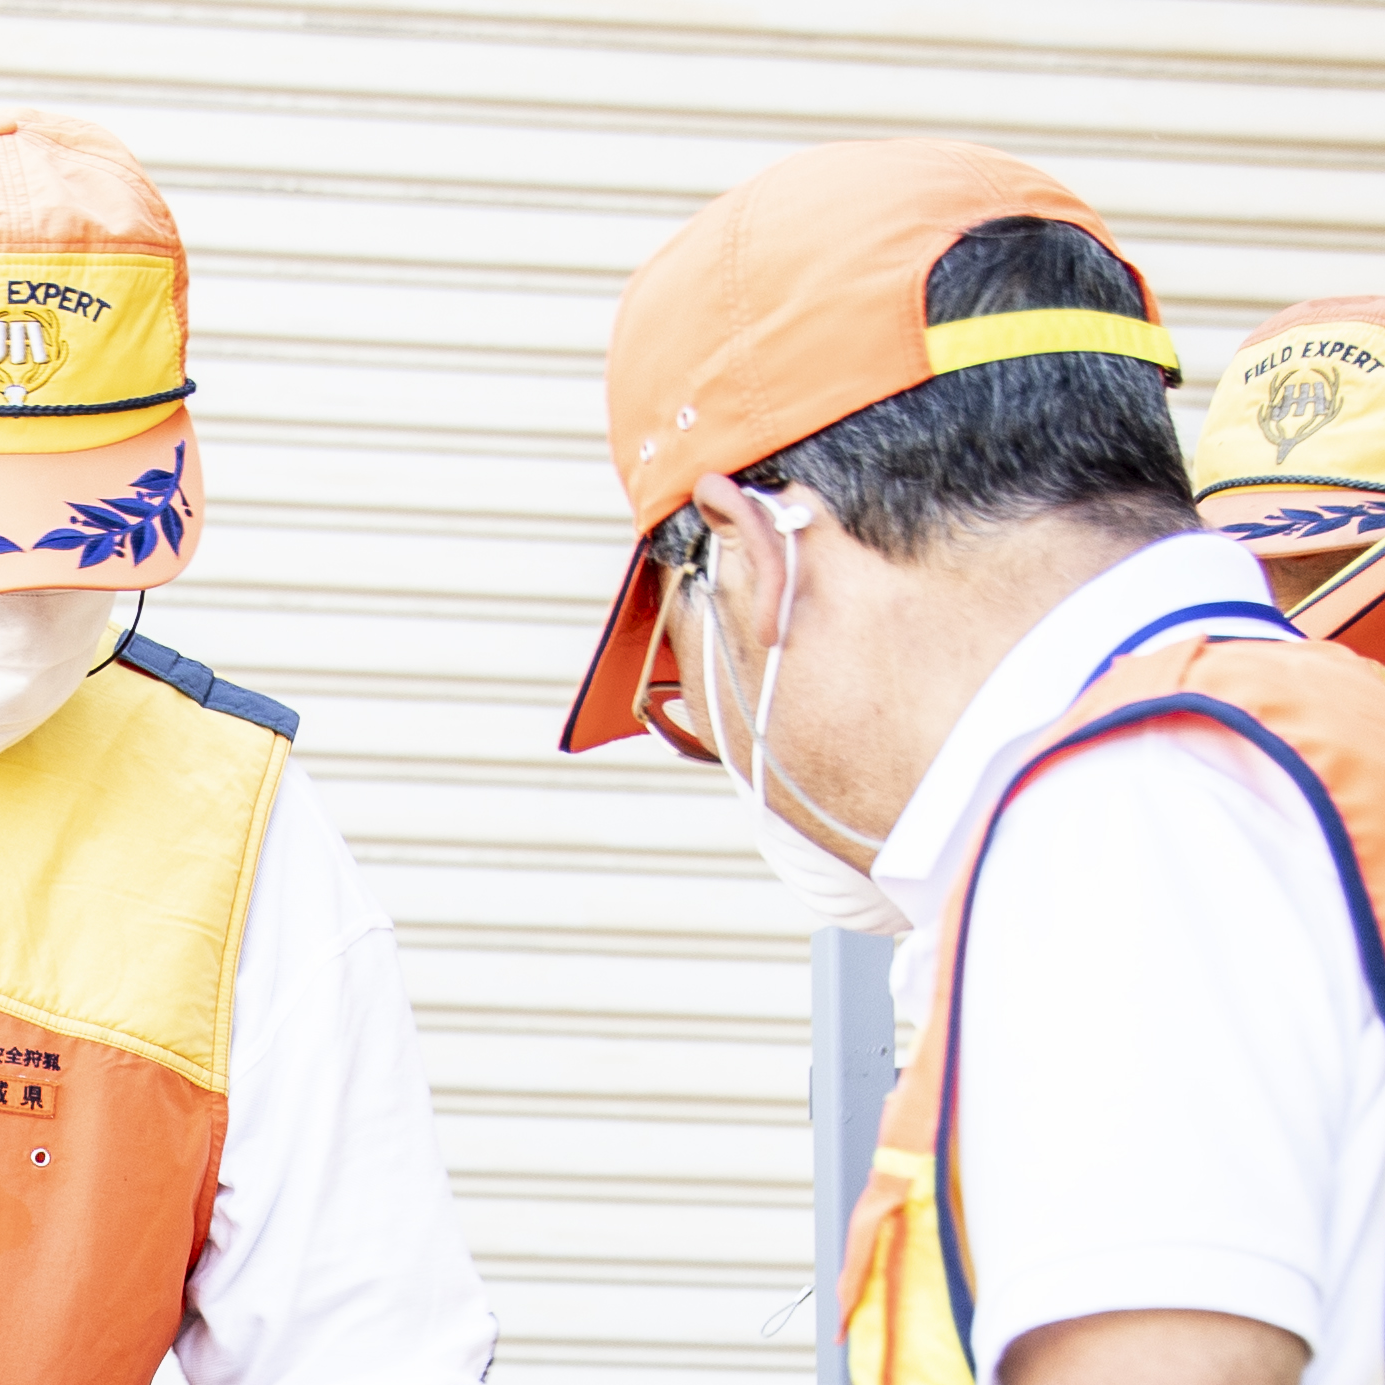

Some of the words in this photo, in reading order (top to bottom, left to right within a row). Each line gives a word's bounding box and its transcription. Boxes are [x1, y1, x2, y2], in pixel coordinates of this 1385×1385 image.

[7, 280, 113, 323] EXPERT
[1244, 345, 1293, 386] FIELD
[1301, 340, 1385, 374] EXPERT
